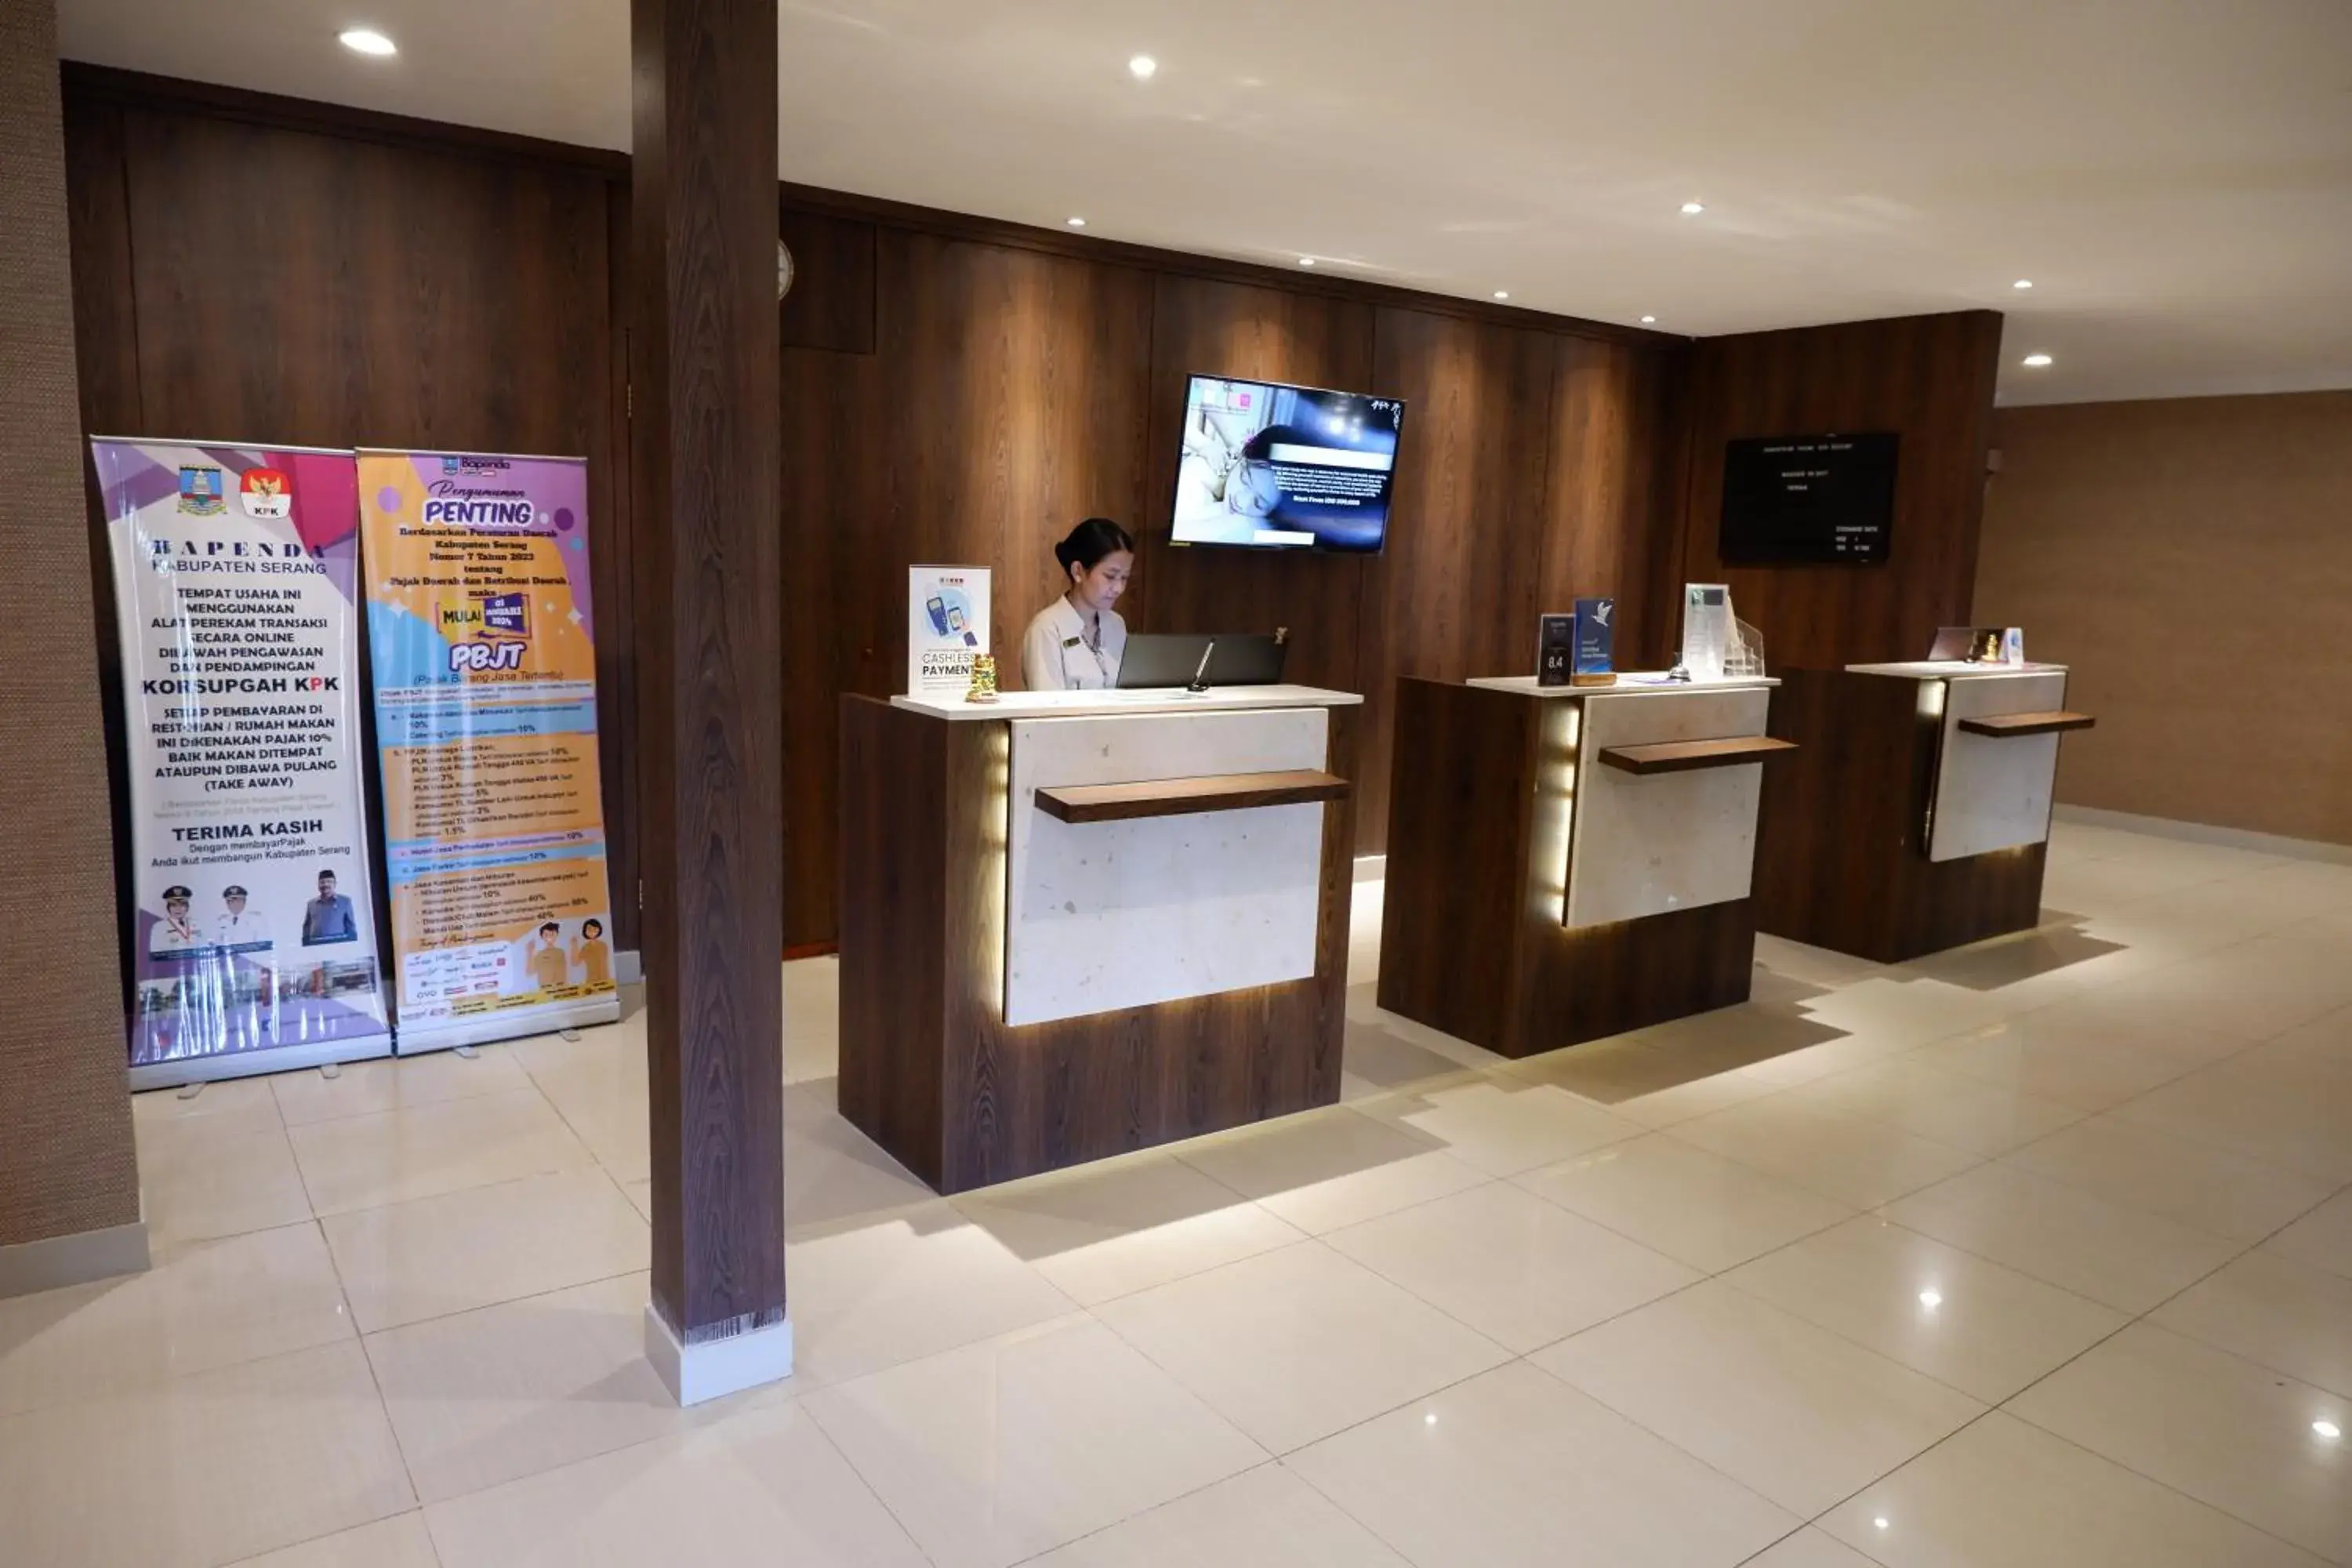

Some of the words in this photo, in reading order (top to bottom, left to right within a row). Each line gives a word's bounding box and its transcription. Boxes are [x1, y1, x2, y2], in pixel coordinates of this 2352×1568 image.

[428, 479, 525, 501] Pengumuman
[255, 506, 279, 517] KPK
[426, 501, 532, 524] PENTING
[400, 528, 467, 536] Berdasarkan
[153, 539, 325, 559] BAPENDA
[435, 539, 490, 550] Kabupaten
[492, 539, 528, 550] Serang
[430, 553, 465, 561] Nomor
[477, 553, 507, 561] Tahun
[261, 561, 327, 575] SERANG
[464, 565, 503, 575] tentang
[423, 576, 460, 586] Daerah
[463, 576, 481, 585] dan
[177, 589, 231, 600] TEMPAT
[236, 589, 278, 600] USAHA
[283, 589, 301, 600] INI
[187, 603, 294, 615] MENGGUNAKAN
[151, 618, 186, 629] ALAT
[191, 618, 256, 629] PEREKAM
[260, 618, 328, 629] TRANSAKSI
[444, 609, 481, 624] MULAI
[245, 632, 295, 644] ONLINE
[159, 648, 227, 659] DIBAWAH
[230, 646, 324, 659] PENGAWASAN
[449, 642, 527, 671] PBJT
[923, 653, 975, 664] CASHLESS
[170, 662, 201, 673] DAN
[205, 661, 315, 673] PENDAMPINGAN
[1548, 656, 1563, 670] 8.4
[143, 677, 287, 695] KORSUPGAH
[295, 676, 339, 692] KPK
[414, 674, 448, 687] (Paak
[492, 671, 517, 681] Jasa
[164, 707, 209, 719] SETIAP
[213, 704, 305, 717] PEMBAYARAN
[310, 704, 322, 714] DI
[235, 720, 284, 731] RUMAH
[288, 717, 335, 729] MAKAN
[157, 738, 176, 749] INI
[180, 735, 261, 747] DIKENAKAN
[265, 733, 306, 745] PAJAK
[309, 733, 332, 742] 10%
[169, 750, 201, 763] BAIK
[205, 749, 255, 761] MAKAN
[260, 746, 323, 759] DITEMPAT
[155, 764, 222, 778] ATAUPUN
[226, 763, 280, 775] DIBAWA
[284, 760, 337, 772] PULANG
[205, 779, 245, 793] (TAKE
[249, 776, 294, 789] AWAY)
[172, 825, 253, 841] TERIMA
[261, 819, 323, 836] KASIH
[189, 842, 227, 855] Dengan
[152, 858, 178, 867] Anda
[202, 852, 263, 865] membangun
[265, 848, 316, 861] Kabupaten
[319, 845, 350, 857] Serang
